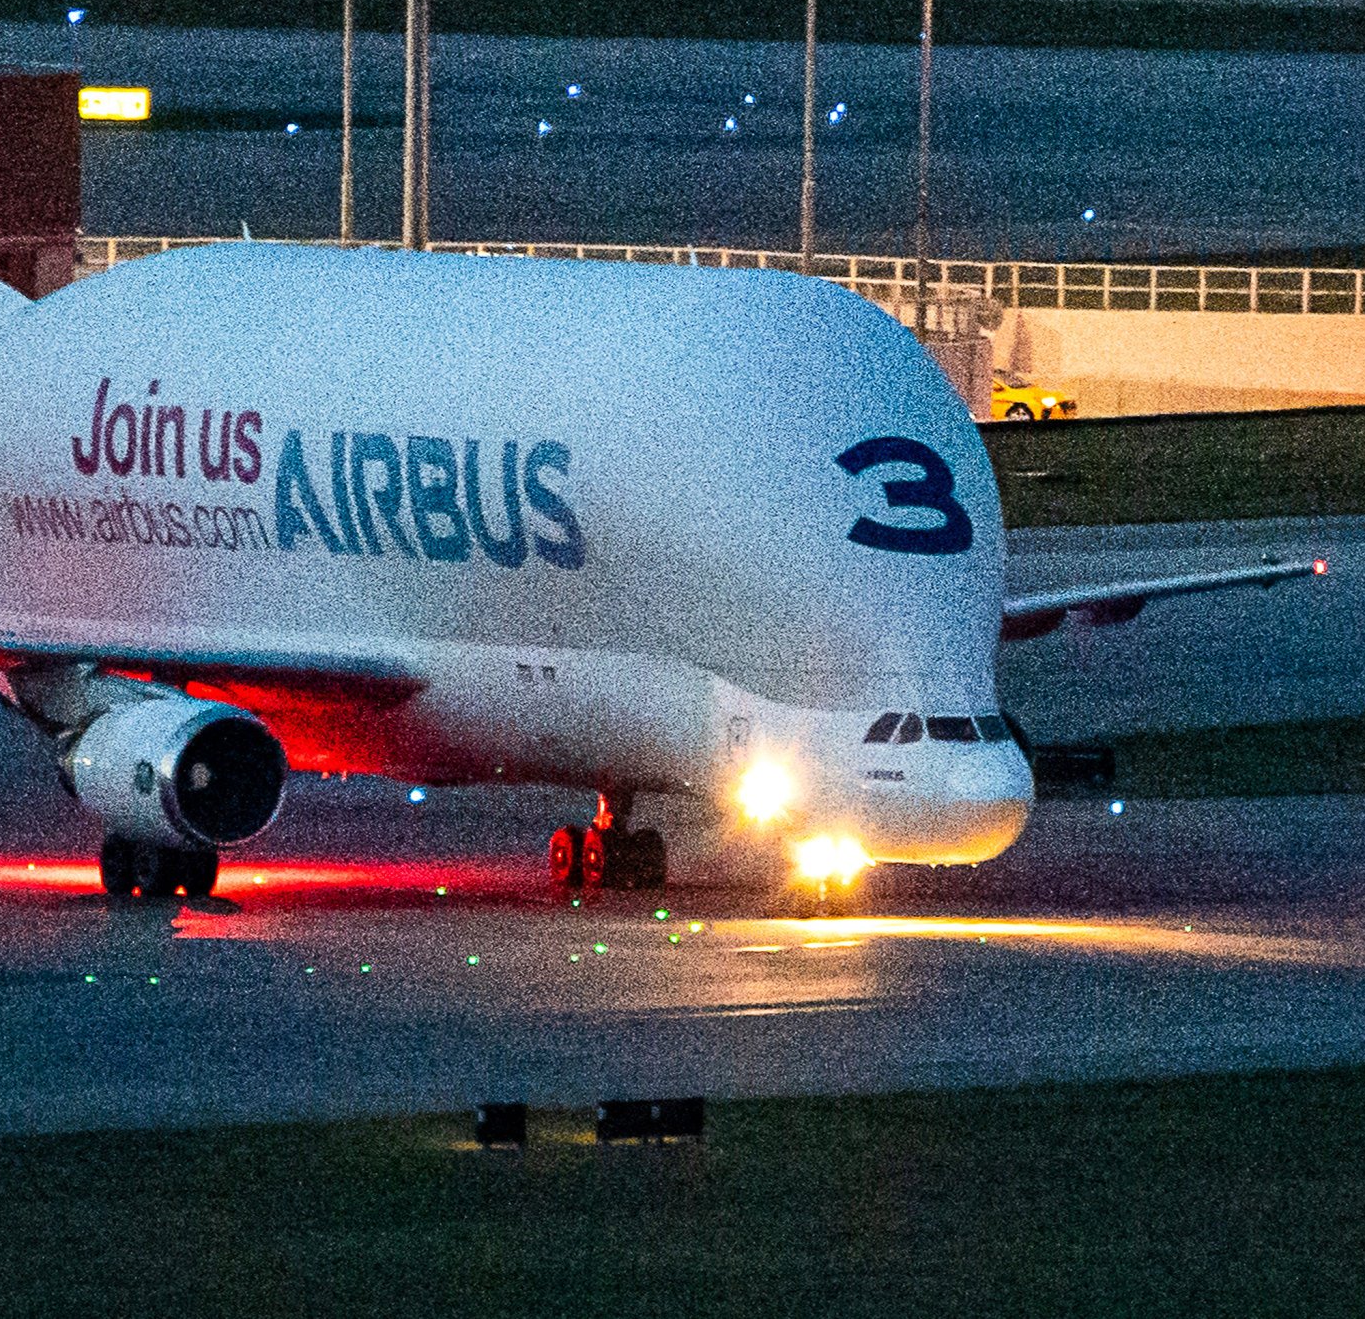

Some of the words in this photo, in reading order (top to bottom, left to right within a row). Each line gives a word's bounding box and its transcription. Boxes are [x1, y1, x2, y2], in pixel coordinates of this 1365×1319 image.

[72, 376, 186, 479] Join
[198, 409, 265, 485] us
[11, 486, 272, 551] www.airbus.com
[274, 428, 587, 571] AIRBUS
[834, 435, 974, 555] 3
